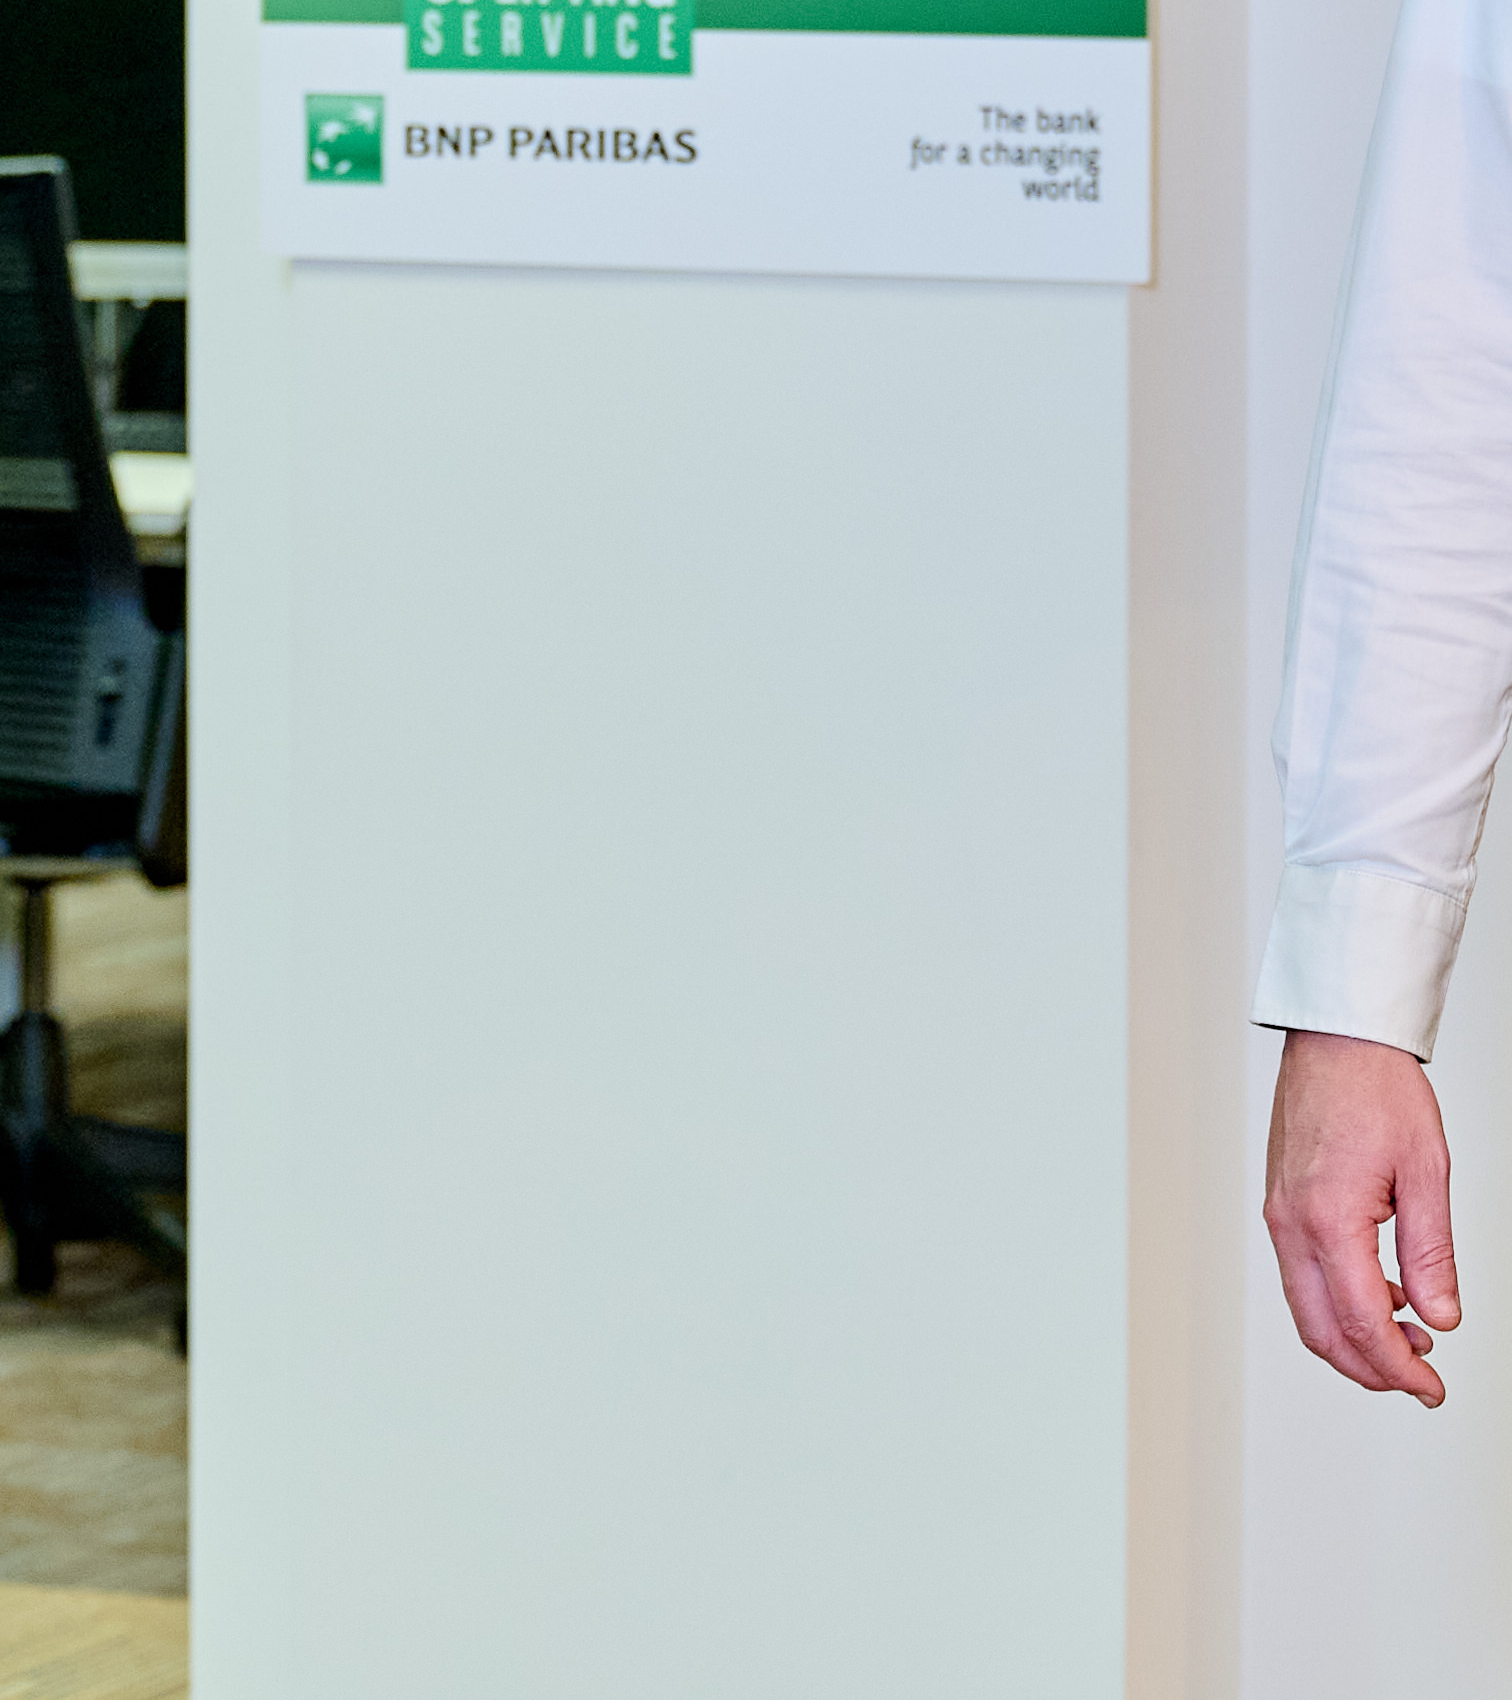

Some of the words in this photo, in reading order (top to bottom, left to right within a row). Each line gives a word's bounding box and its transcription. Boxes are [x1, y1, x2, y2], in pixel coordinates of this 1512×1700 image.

[422, 12, 678, 60] SERVICE
[980, 107, 1027, 132] The
[1037, 108, 1100, 134] bank
[404, 124, 494, 158] BNP
[508, 128, 698, 164] PARIBAS
[910, 137, 947, 170] for
[957, 145, 971, 165] a
[980, 141, 1100, 173] changing
[1024, 176, 1100, 202] world
